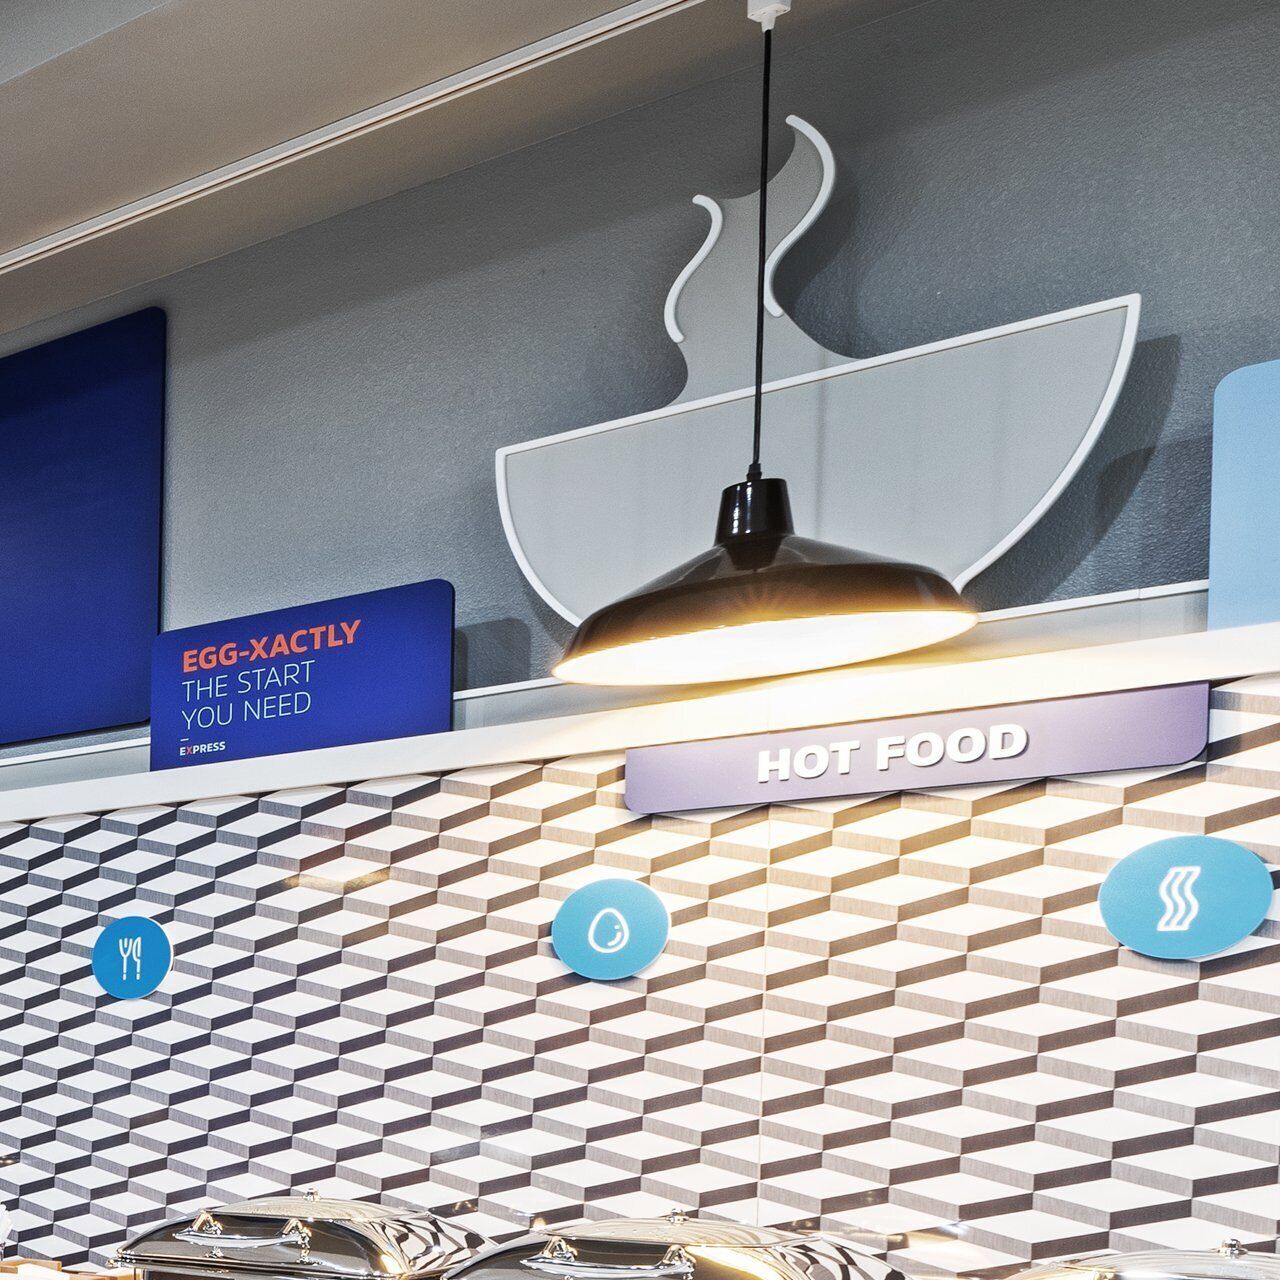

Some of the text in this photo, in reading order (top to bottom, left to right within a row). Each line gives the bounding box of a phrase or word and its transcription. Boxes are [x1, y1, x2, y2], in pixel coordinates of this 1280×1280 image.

[182, 619, 362, 673] EGG-XACTLY
[181, 659, 316, 702] THE START
[181, 691, 312, 730] YOU NEED
[179, 740, 226, 756] EXPRESS
[757, 723, 1029, 784] HOT FOOD
